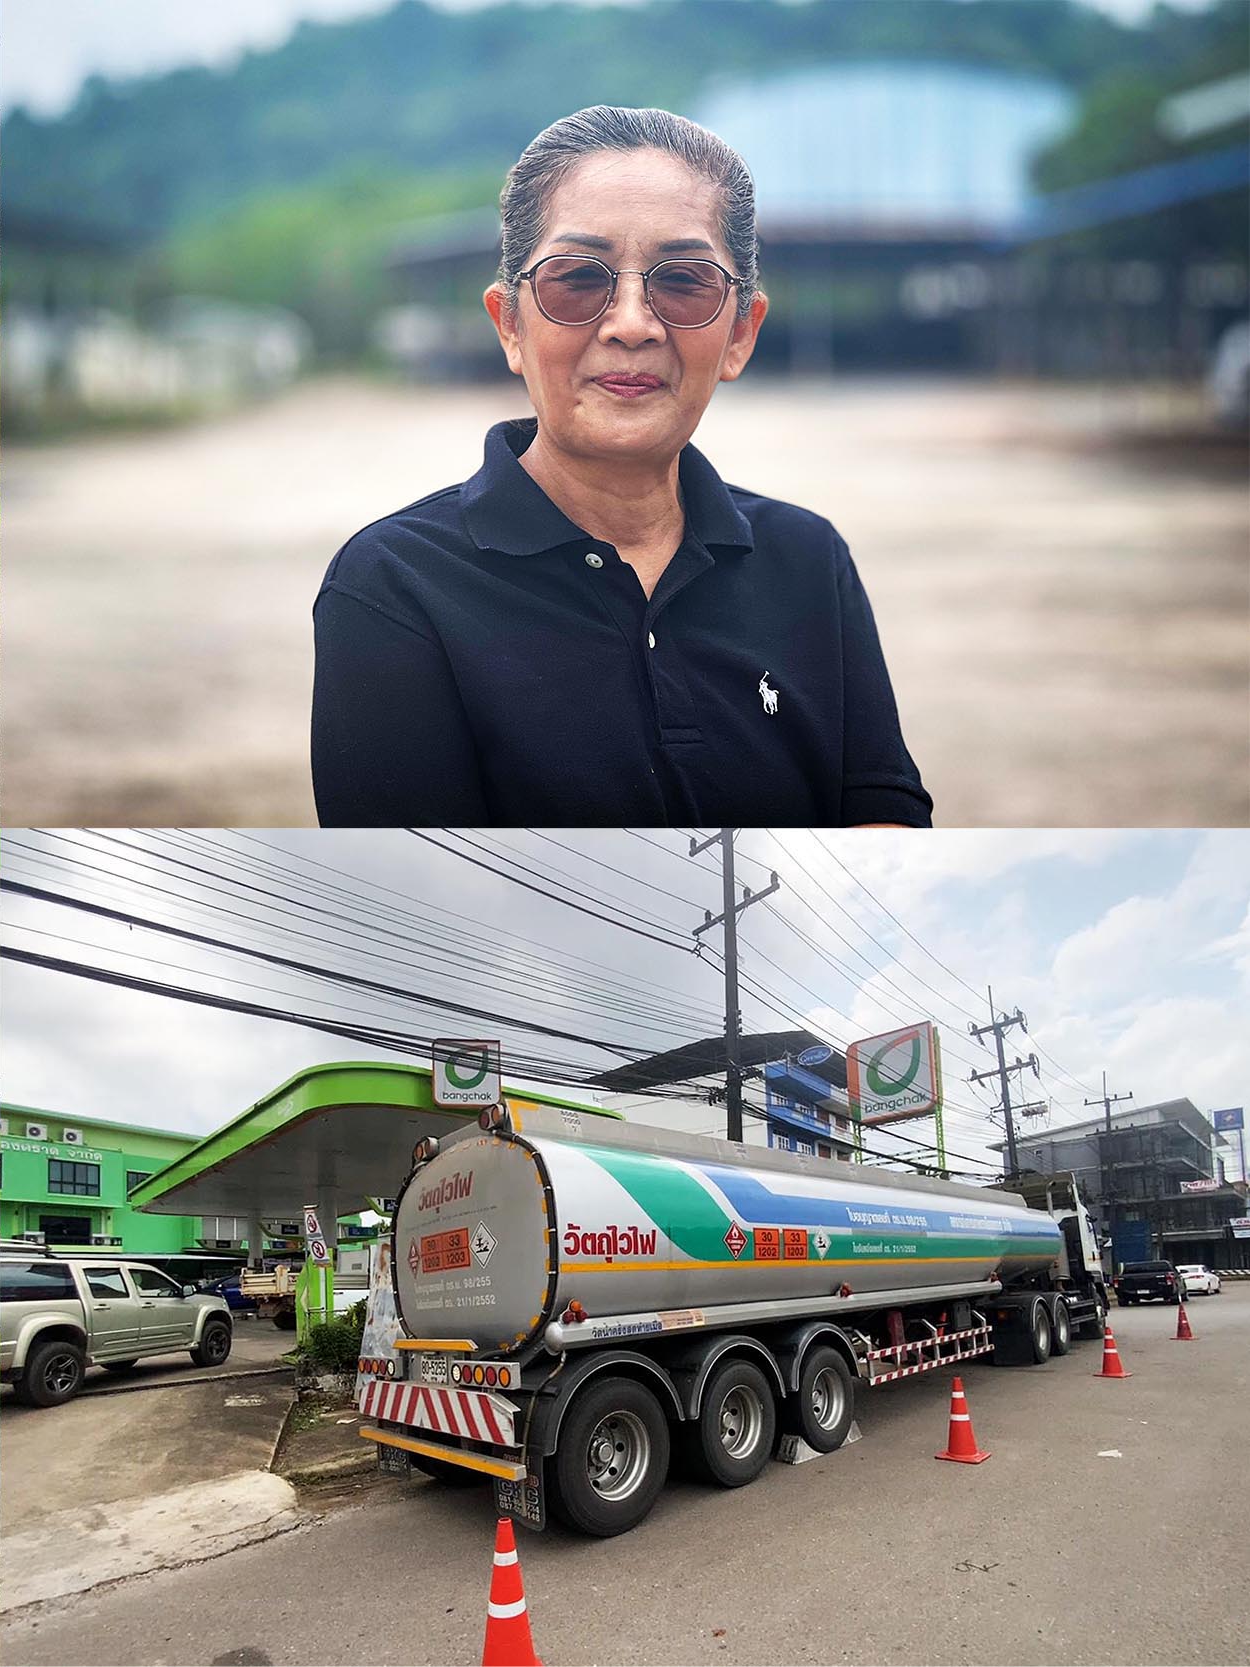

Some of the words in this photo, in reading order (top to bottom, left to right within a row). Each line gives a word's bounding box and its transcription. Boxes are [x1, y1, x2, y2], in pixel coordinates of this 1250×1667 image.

[442, 1091, 492, 1102] bangchak
[864, 1093, 928, 1115] bangchak
[67, 1146, 103, 1161] จำกัด
[448, 1234, 461, 1247] 33
[761, 1231, 773, 1243] 30
[790, 1232, 801, 1243] 33
[563, 1223, 657, 1264] วัตถุไวไฟ
[446, 1251, 466, 1263] 1203
[757, 1246, 777, 1257] 1202
[786, 1246, 804, 1257] 1203
[456, 1294, 497, 1307] 21/1/2552
